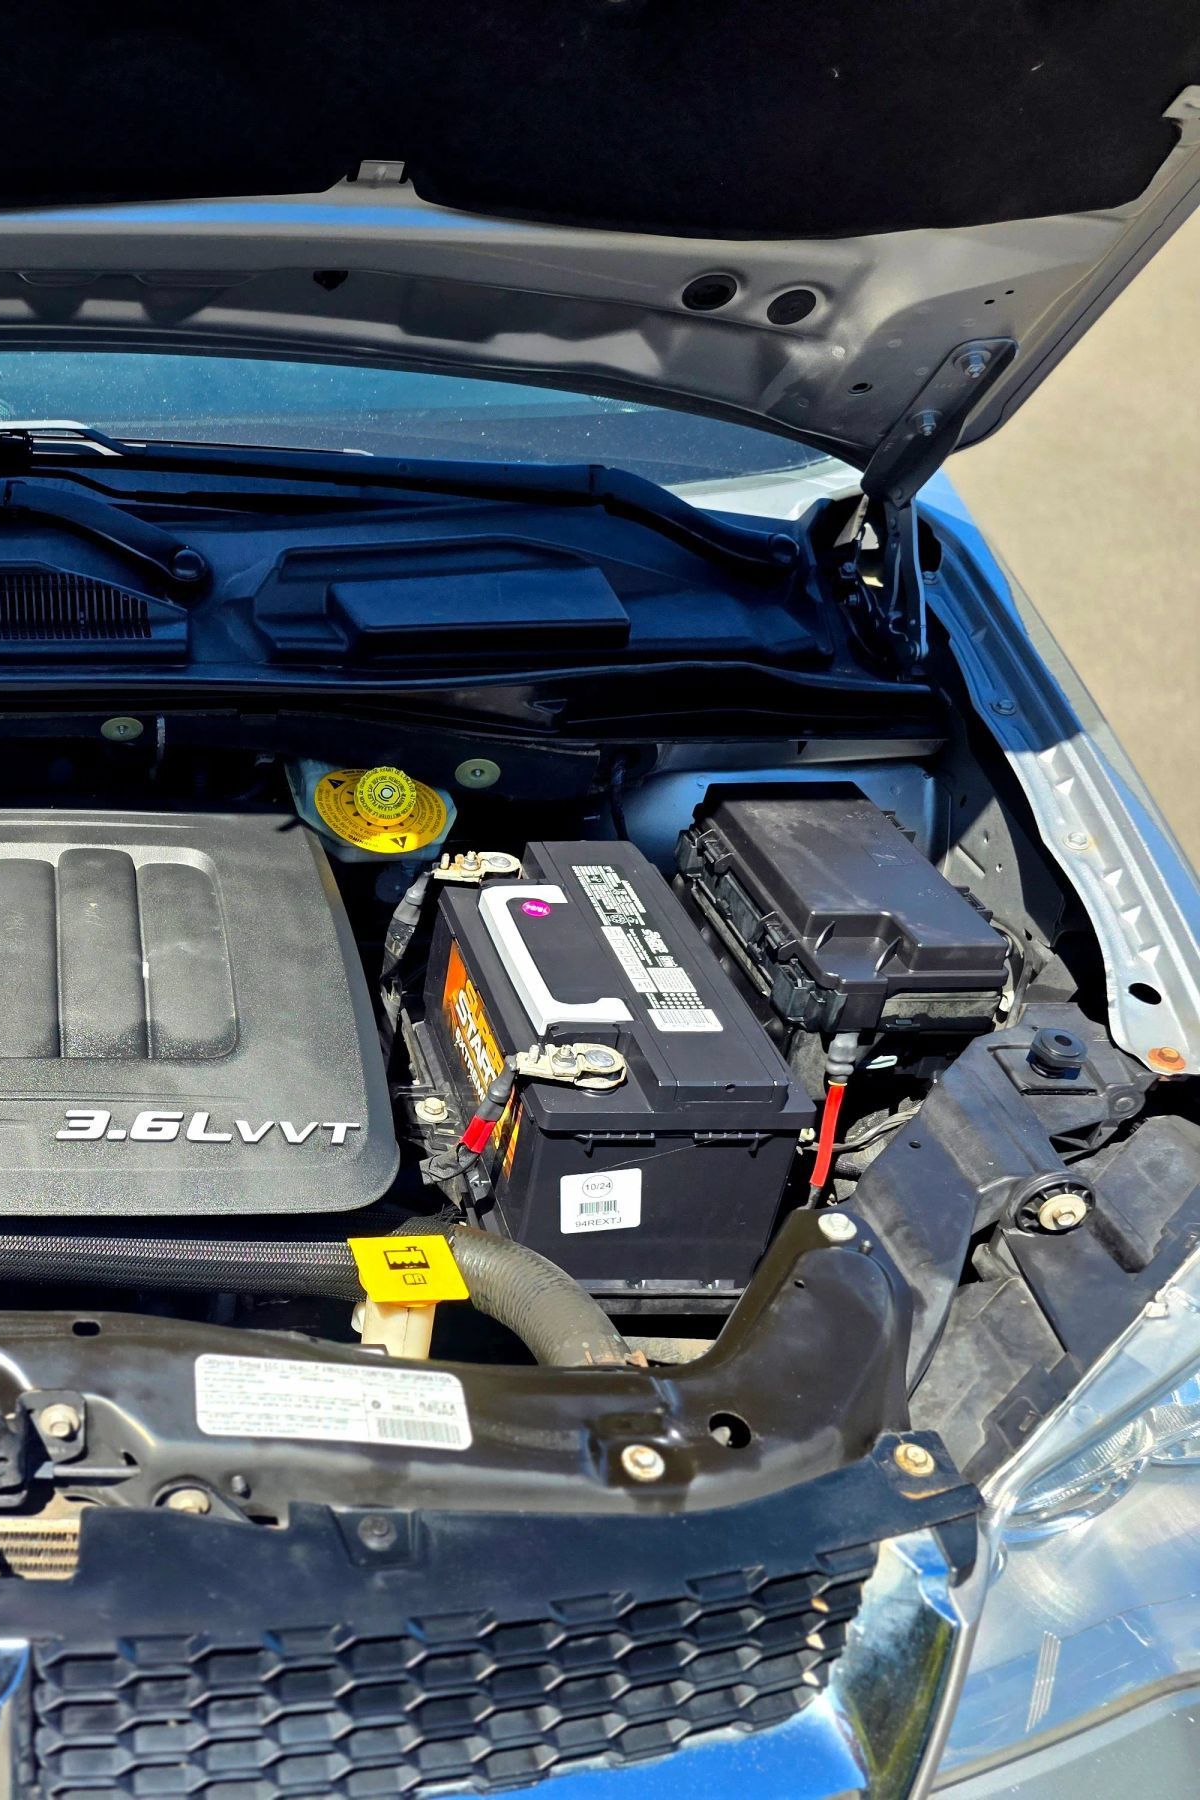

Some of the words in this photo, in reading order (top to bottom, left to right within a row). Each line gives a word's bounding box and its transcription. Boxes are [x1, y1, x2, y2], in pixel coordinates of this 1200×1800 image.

[55, 1110, 232, 1143] 3.6L
[235, 1119, 360, 1145] VVT
[585, 1182, 611, 1191] 10/24
